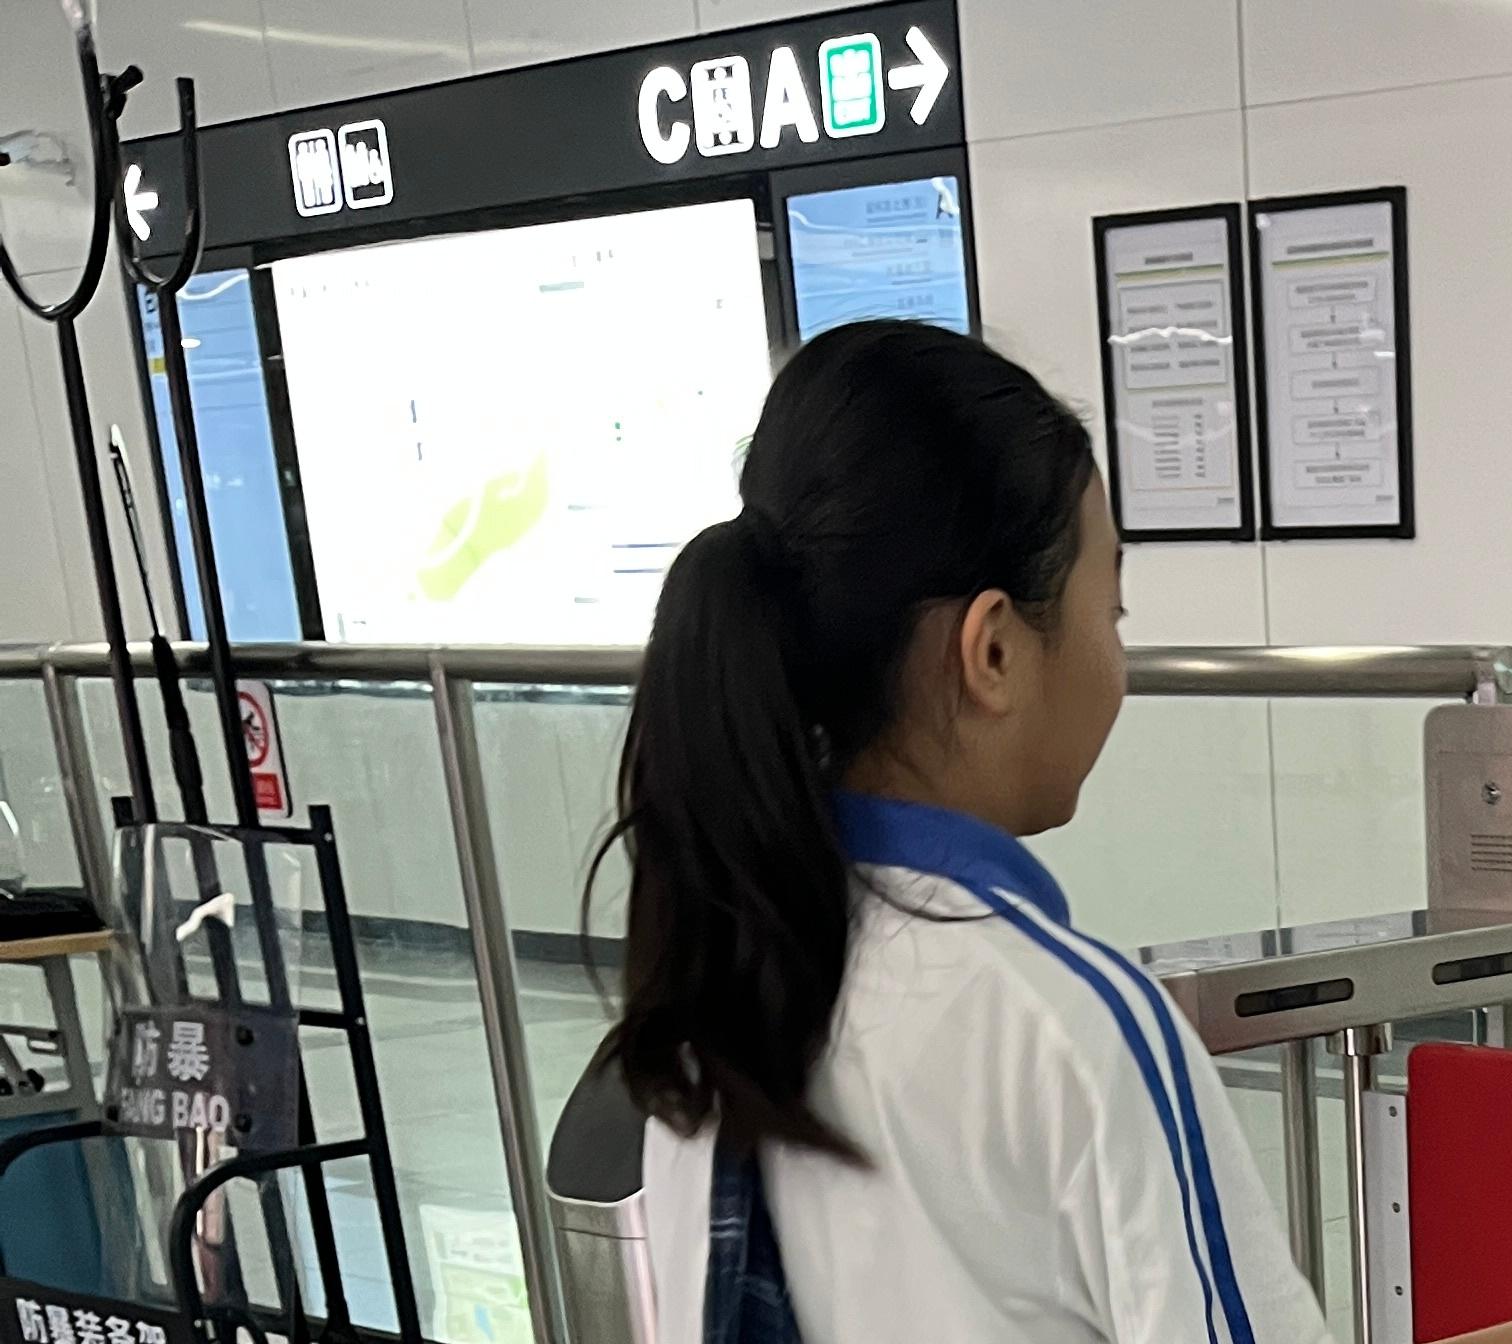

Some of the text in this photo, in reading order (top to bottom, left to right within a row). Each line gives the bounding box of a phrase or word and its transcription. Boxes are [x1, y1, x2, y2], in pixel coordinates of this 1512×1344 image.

[638, 66, 691, 164] C
[759, 46, 820, 149] A
[131, 1019, 211, 1085] 防暴
[171, 1090, 230, 1132] BAO
